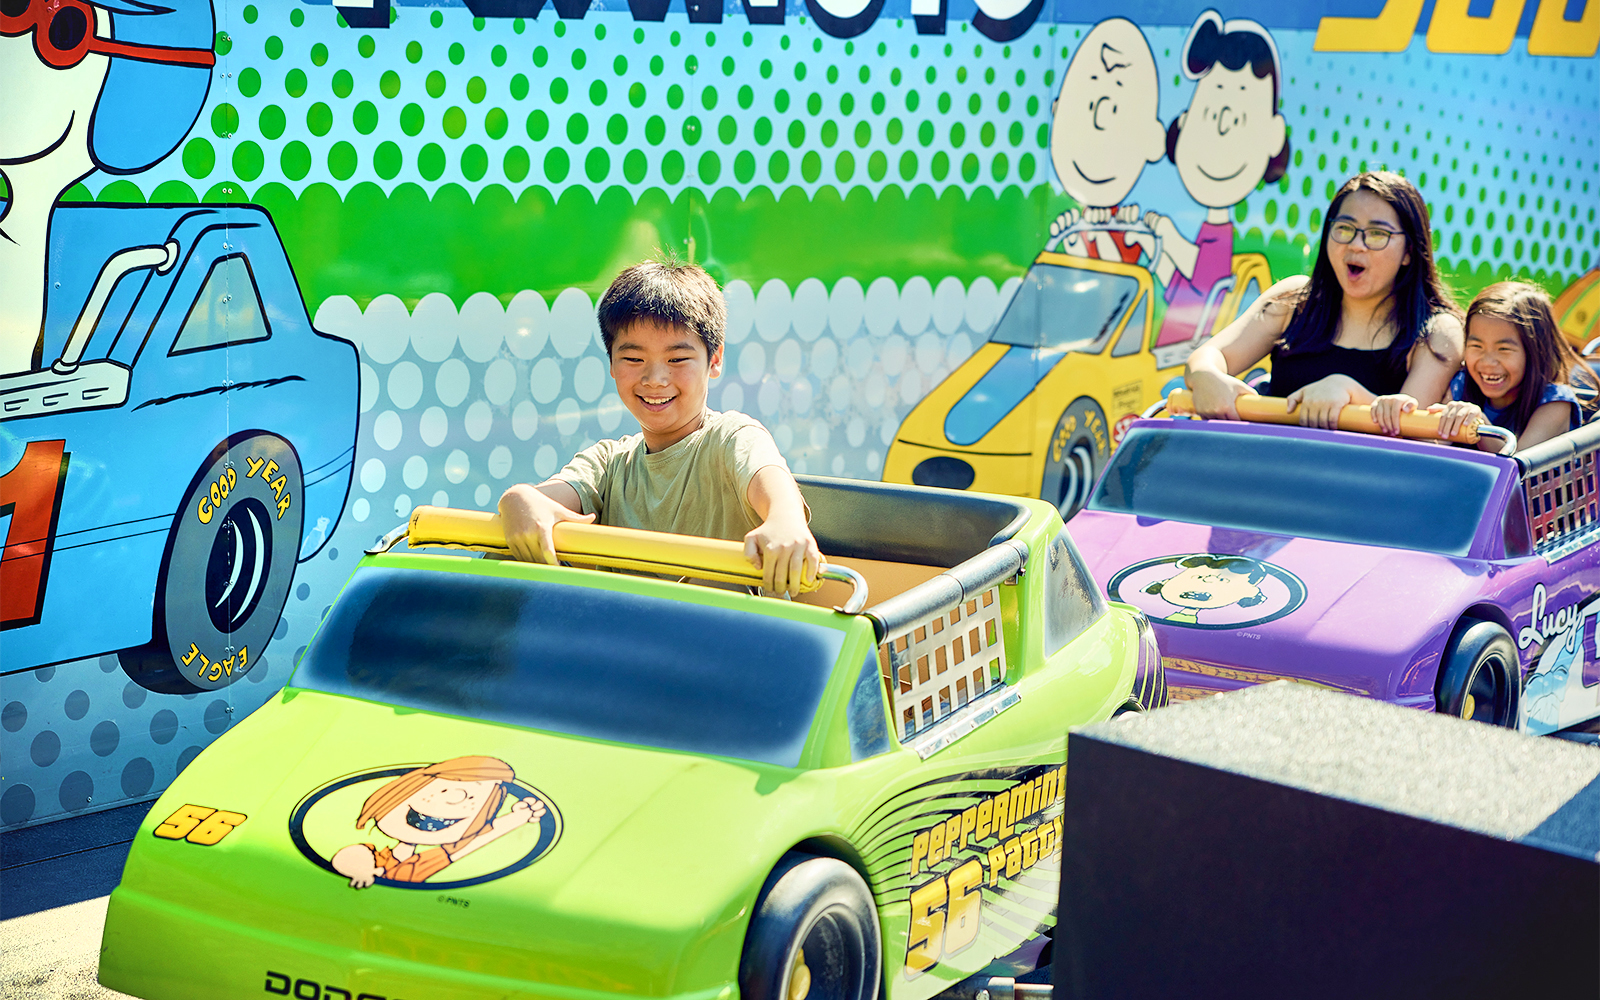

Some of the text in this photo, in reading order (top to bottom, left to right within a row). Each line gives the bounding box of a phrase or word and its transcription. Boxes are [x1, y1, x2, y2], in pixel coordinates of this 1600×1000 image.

[197, 456, 291, 525] GOOD YEAR
[1518, 582, 1580, 655] Lucy
[180, 641, 249, 682] EAGLE
[153, 803, 248, 846] 56
[903, 853, 984, 983] 56
[264, 970, 405, 1000] DOD
